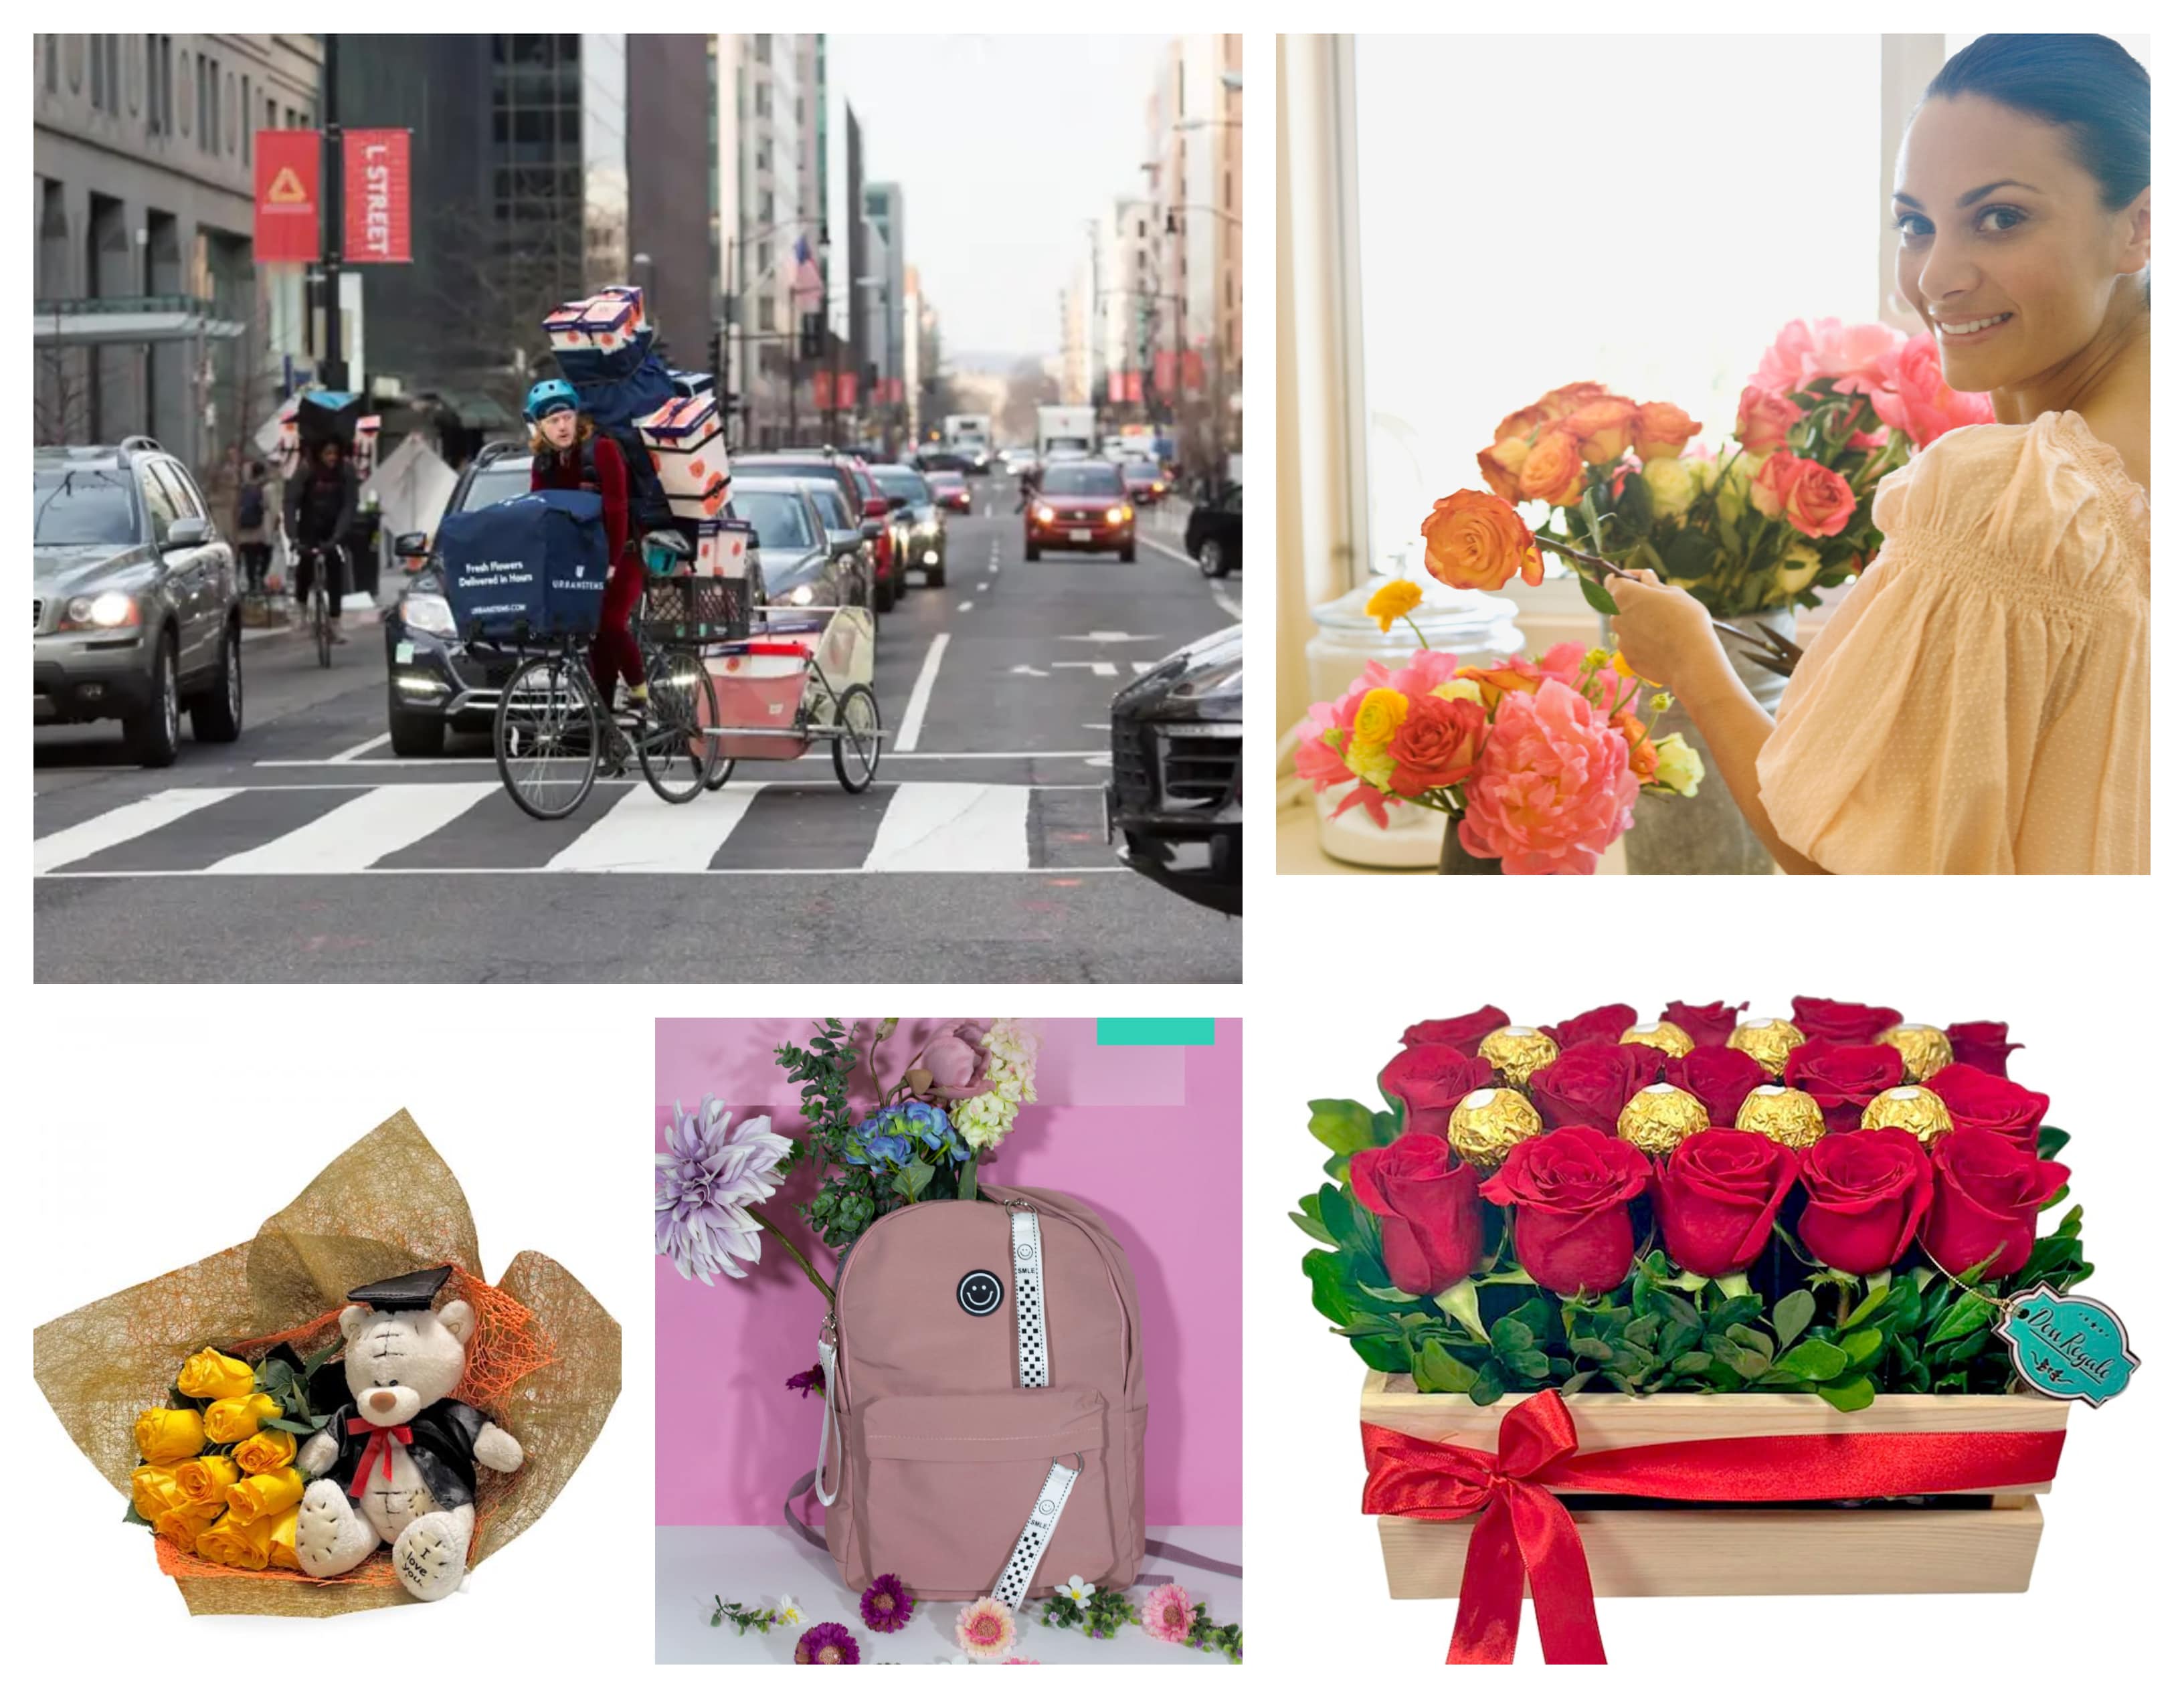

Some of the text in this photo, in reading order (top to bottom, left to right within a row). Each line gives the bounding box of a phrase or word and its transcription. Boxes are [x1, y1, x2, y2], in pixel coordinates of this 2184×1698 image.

[365, 144, 389, 254] L STREET
[466, 561, 524, 573] Fresh Flowers
[459, 573, 533, 587] Delivered in Hours
[420, 1547, 431, 1560] I
[407, 1551, 428, 1576] love
